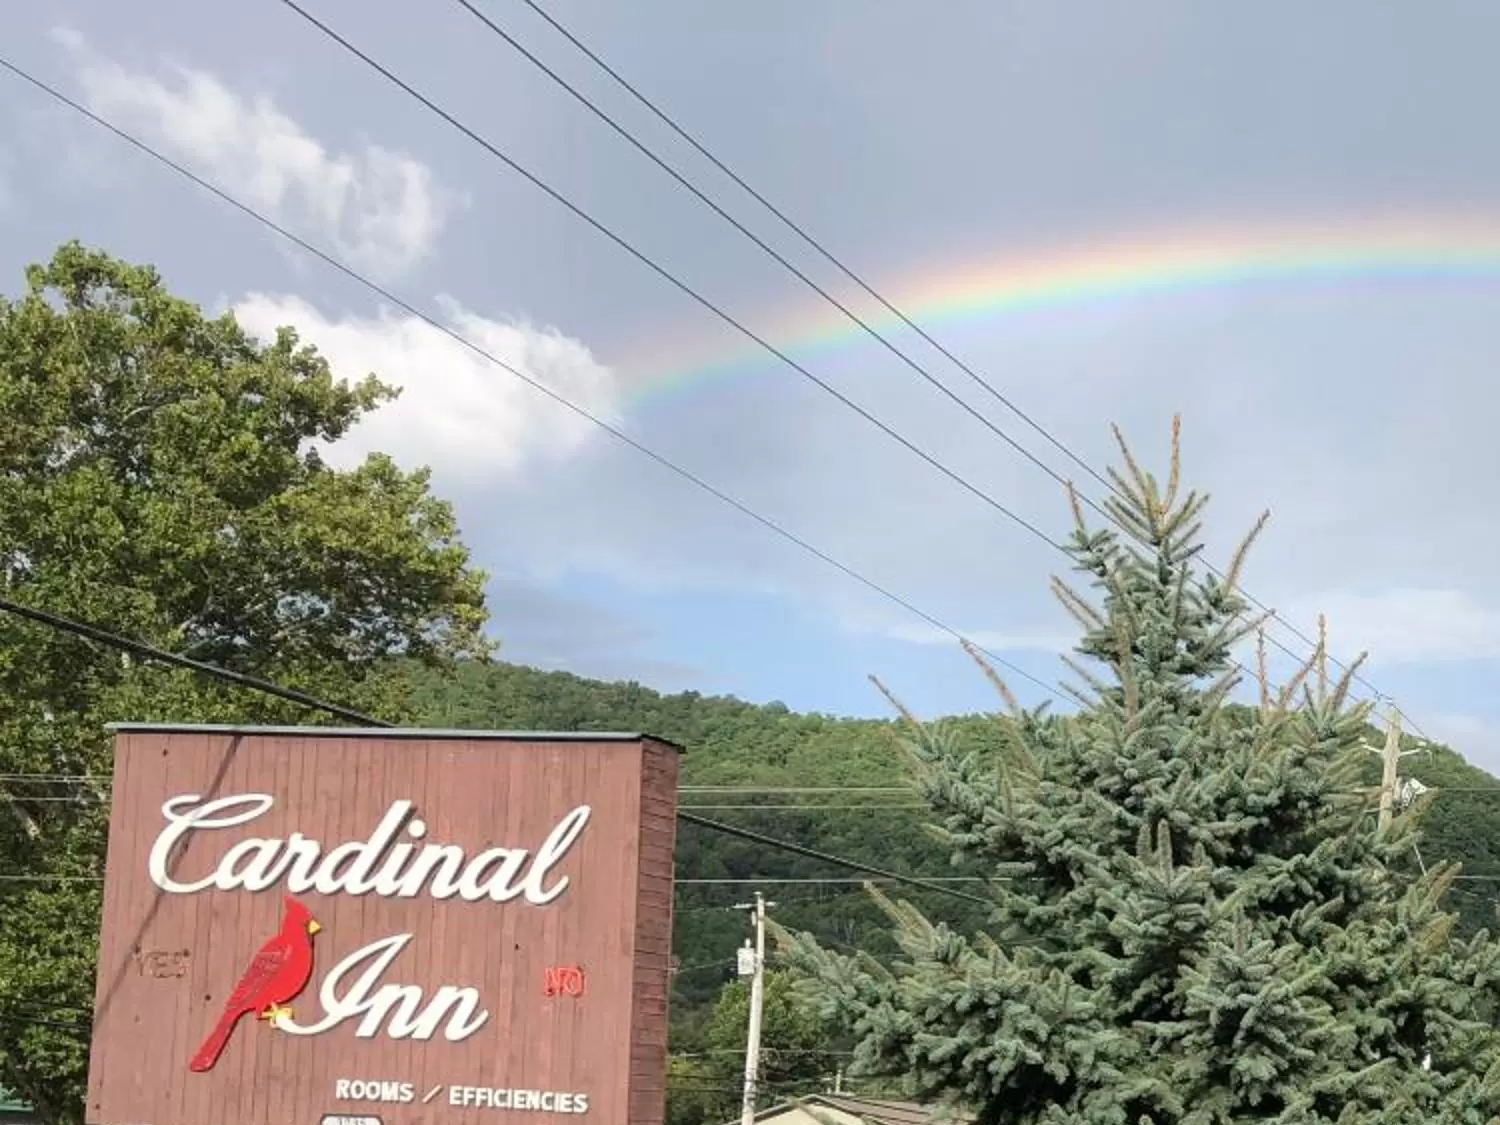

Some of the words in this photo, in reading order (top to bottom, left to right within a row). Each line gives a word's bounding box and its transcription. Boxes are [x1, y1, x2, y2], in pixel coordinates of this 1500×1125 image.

[148, 793, 591, 905] Cardinal
[275, 933, 489, 1041] Inn
[335, 1079, 415, 1102] ROOMS
[449, 1085, 589, 1113] EFFICIENCIES
